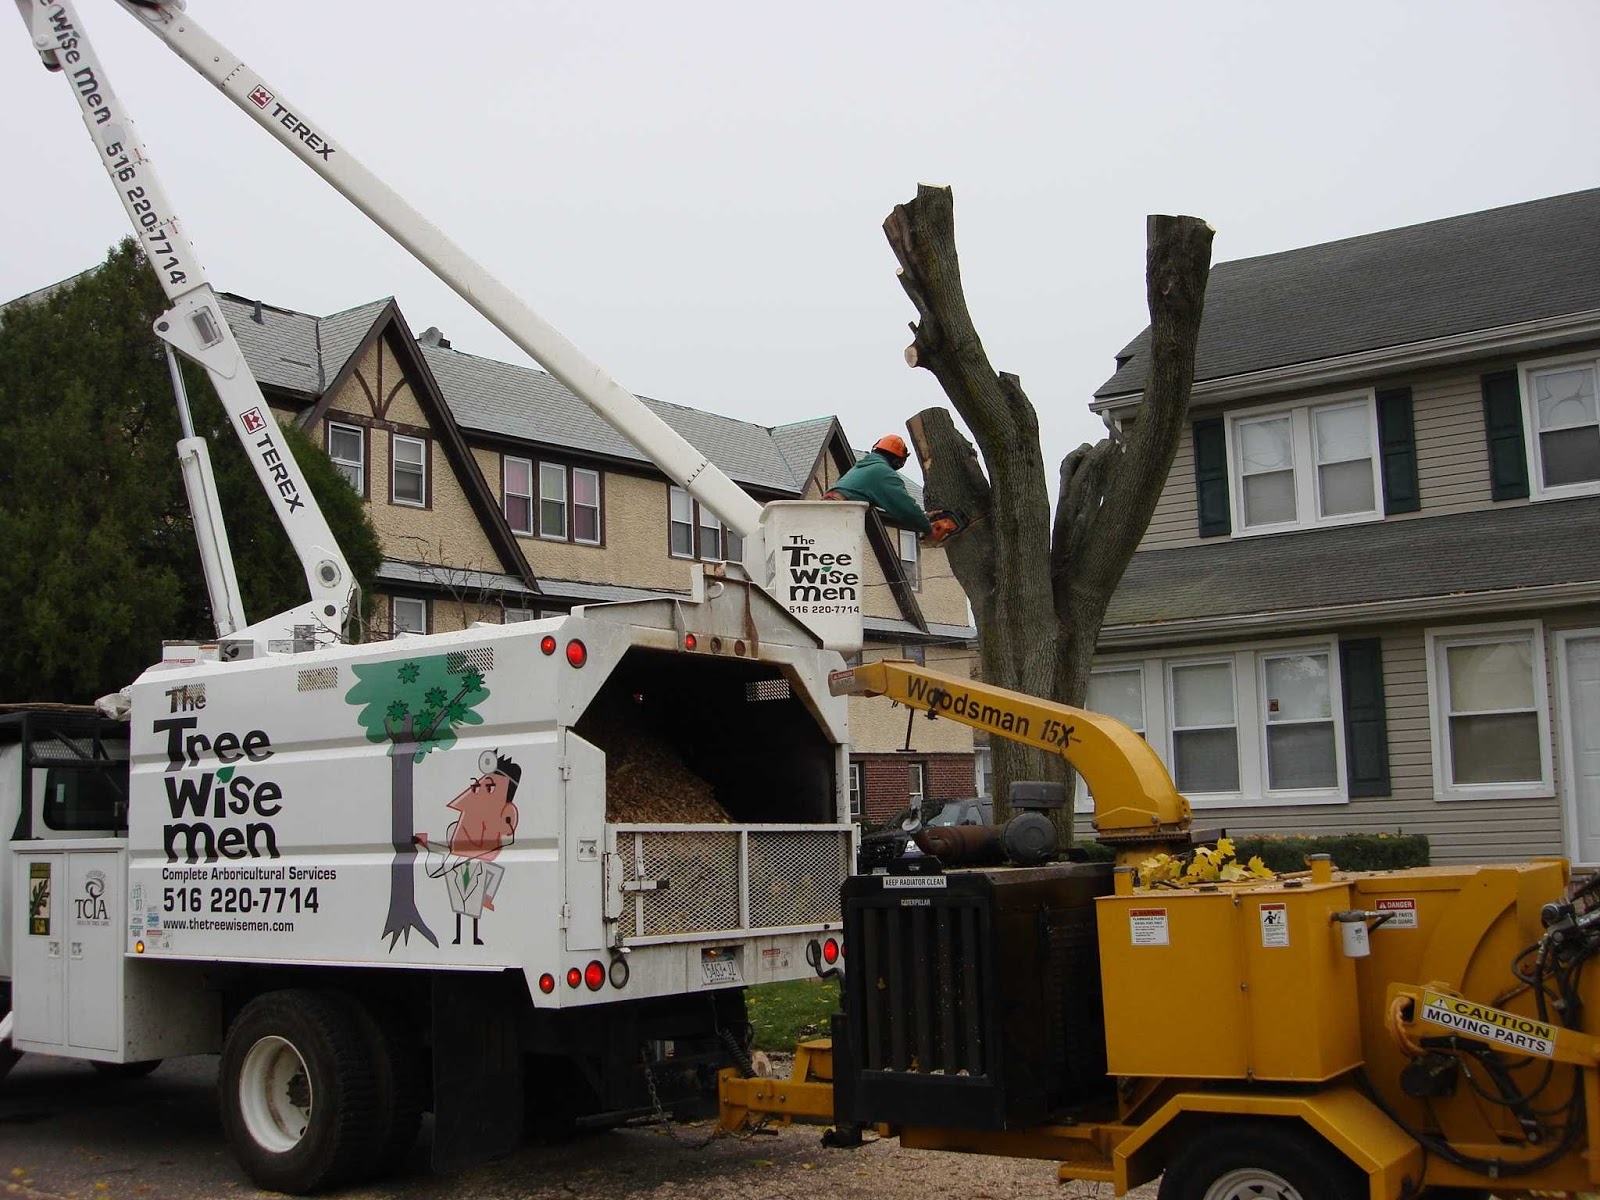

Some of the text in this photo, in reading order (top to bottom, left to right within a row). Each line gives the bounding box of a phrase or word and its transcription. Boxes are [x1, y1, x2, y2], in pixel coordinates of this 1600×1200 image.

[73, 66, 112, 125] men
[272, 102, 336, 161] TEREX
[105, 142, 186, 285] 516 220-7714
[256, 433, 305, 514] TEREX
[789, 535, 815, 545] The
[782, 546, 852, 567] Tree
[789, 585, 856, 601] men
[812, 605, 860, 614] 220-7714
[165, 684, 206, 713] The
[907, 675, 1029, 736] Woodsman
[153, 716, 275, 772] Tree
[163, 822, 281, 864] men
[162, 866, 337, 883] Complete Arboricultural Services
[885, 878, 945, 886] KEEP RADIATOR CLEAN
[75, 898, 108, 919] TCIA
[163, 887, 202, 912] 516
[210, 887, 319, 913] 220-7714
[1387, 901, 1413, 909] DANGER
[163, 918, 294, 932] www.thetreewisemen.com
[1427, 1008, 1546, 1052] MOVING PARTS
[1454, 1003, 1550, 1039] CAUTION
